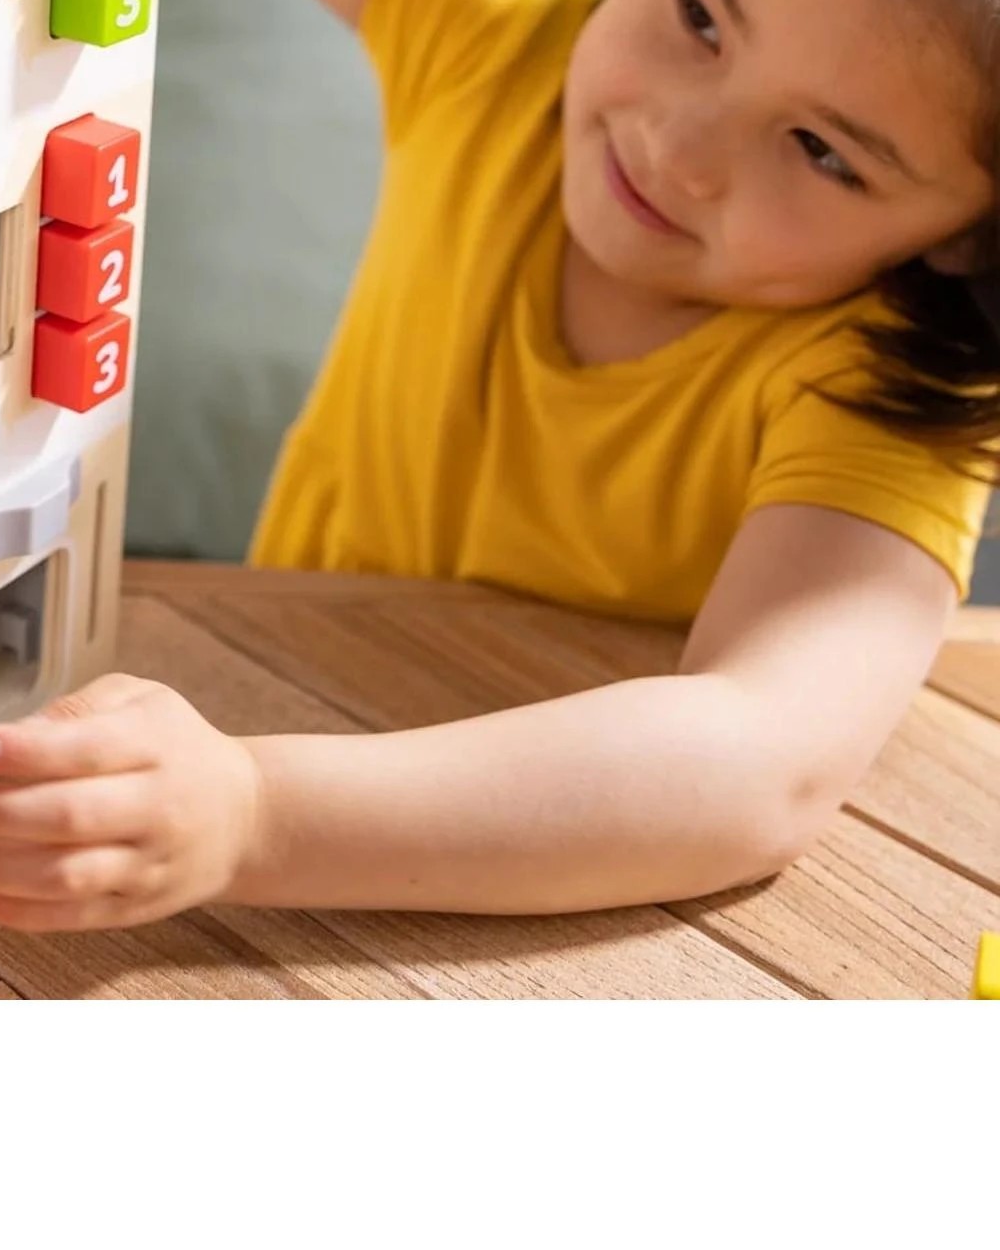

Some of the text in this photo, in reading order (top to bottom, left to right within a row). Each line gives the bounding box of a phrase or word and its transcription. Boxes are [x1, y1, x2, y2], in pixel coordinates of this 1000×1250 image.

[108, 155, 128, 208] 1
[99, 250, 122, 303] 2
[93, 342, 119, 394] 3
